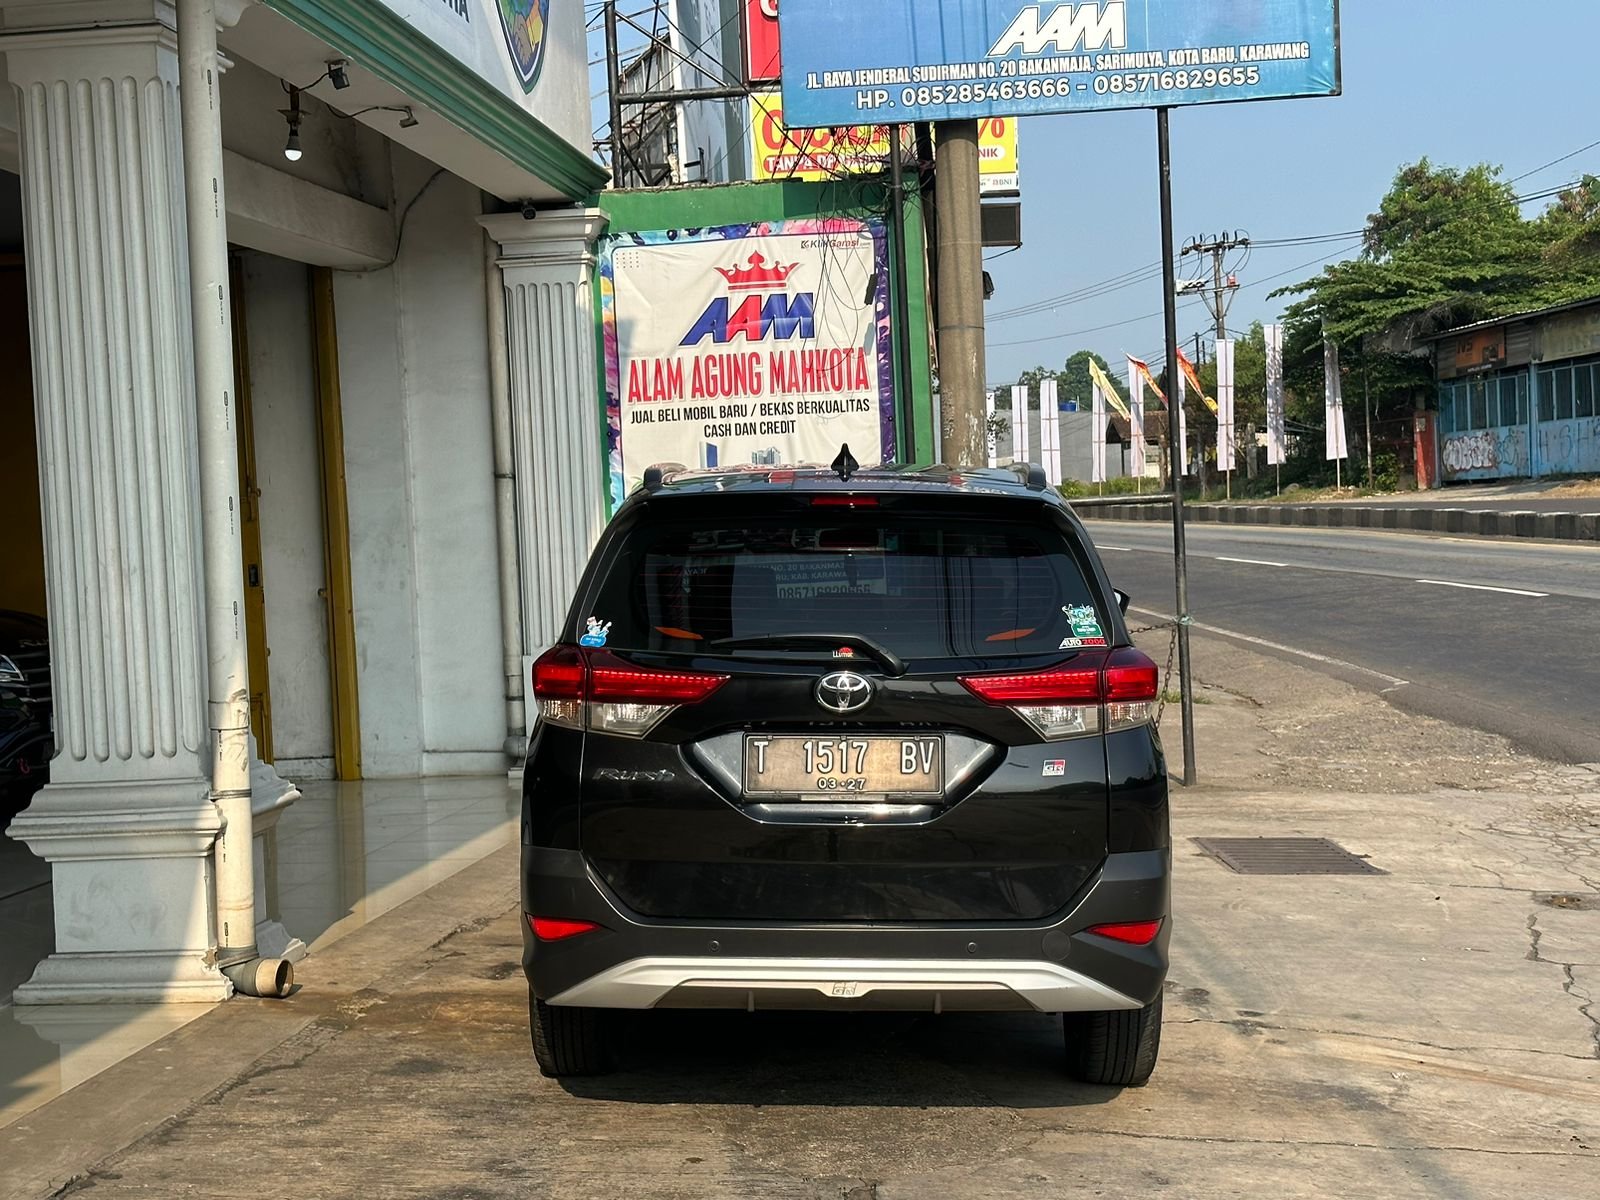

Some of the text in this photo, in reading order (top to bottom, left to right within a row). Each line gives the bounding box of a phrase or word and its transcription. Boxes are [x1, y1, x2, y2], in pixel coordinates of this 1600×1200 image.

[986, 1, 1127, 57] AAM
[807, 41, 1309, 89] JL. RAYA JENDERAL SUDIRMAN NO. 20 BAKANMAJA, SARIMULYA, KOTA BARU, KARAWANG
[856, 89, 896, 110] HP.
[901, 77, 1070, 107] 085285463666
[1093, 66, 1260, 95] 085716829655
[679, 292, 815, 346] AAM
[628, 347, 870, 403] ALAM AGUNG MAHKOTA
[631, 398, 870, 424] JUAL BELI MOBIL BARU / BEKAS BERKUALITAS
[704, 420, 796, 438] CASH DAN CREDIT
[754, 741, 934, 774] T 1517 BV
